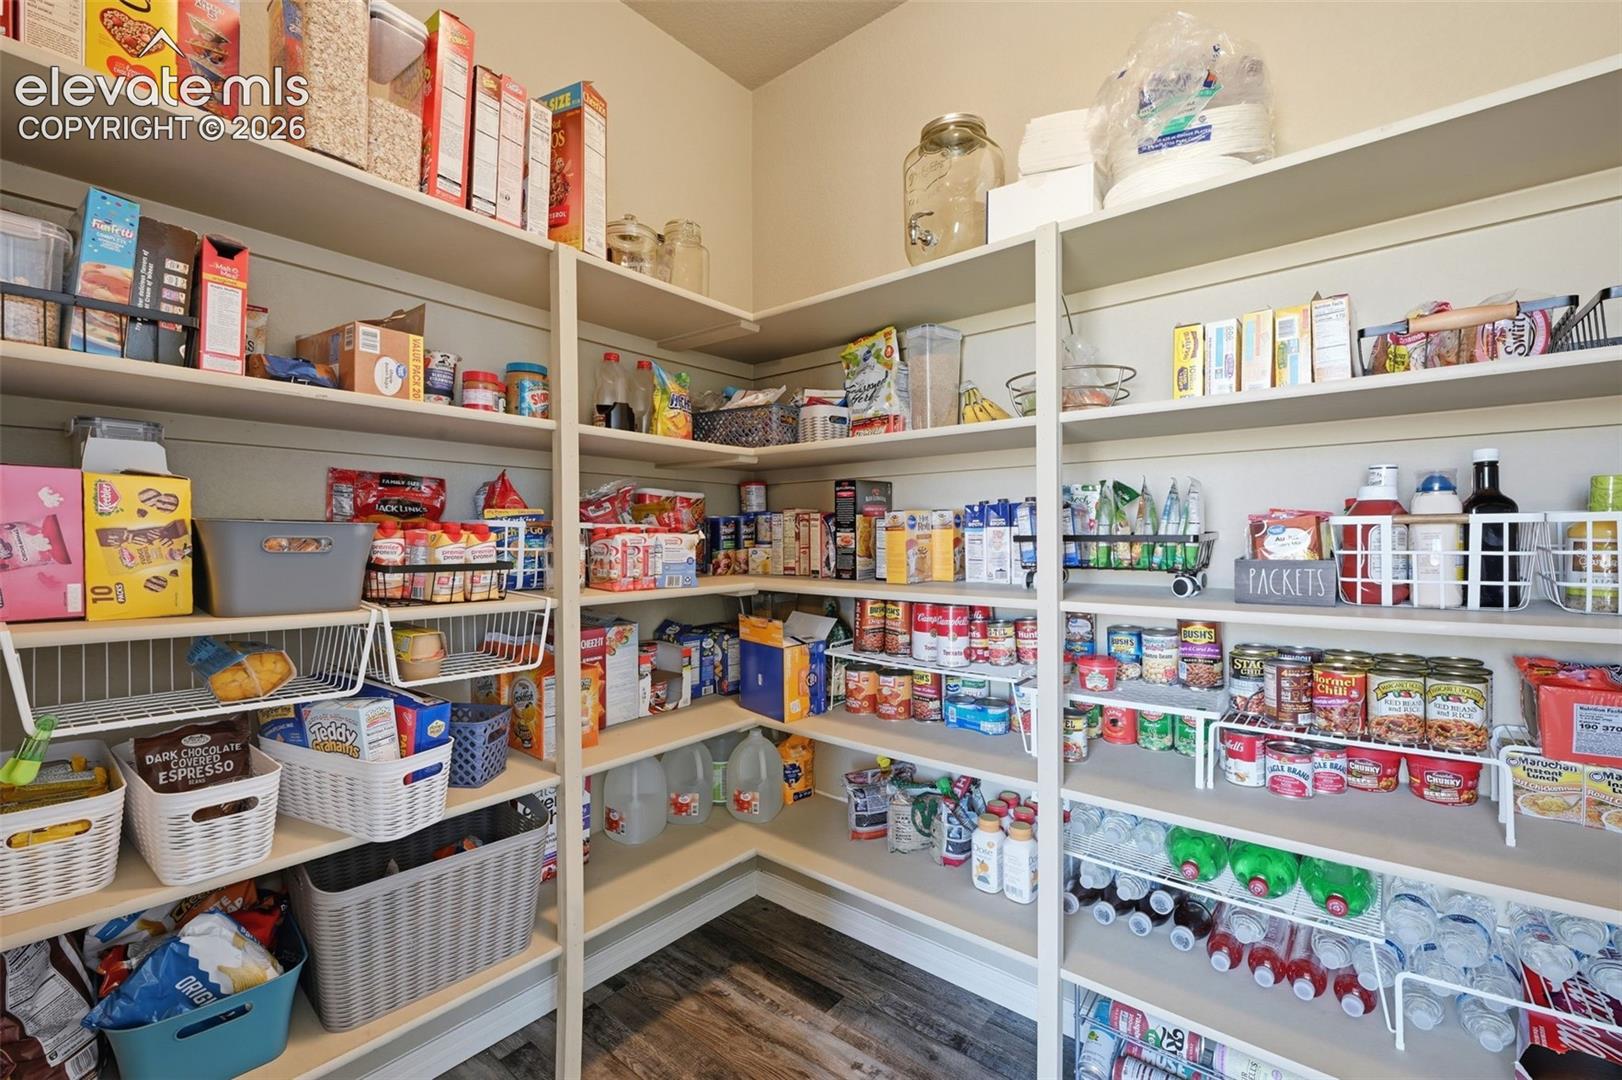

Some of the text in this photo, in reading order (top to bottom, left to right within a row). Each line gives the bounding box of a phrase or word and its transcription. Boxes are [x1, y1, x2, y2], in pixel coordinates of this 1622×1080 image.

[549, 92, 571, 108] SIZE
[412, 338, 423, 363] VALUE
[412, 364, 422, 387] PACK
[381, 478, 405, 487] FAMILY
[98, 483, 111, 513] Keebler
[375, 503, 399, 513] JACK
[1249, 568, 1325, 598] PACKETS
[91, 584, 115, 605] 10
[116, 583, 125, 603] PACKS
[1181, 629, 1215, 641] BUSH'S
[1240, 667, 1264, 677] CHIL
[1316, 683, 1348, 697] Chili
[1384, 699, 1400, 707] RED
[1433, 702, 1478, 714] RED BEANS
[1436, 708, 1474, 719] and RICE
[310, 721, 357, 748] Teddy
[1579, 723, 1622, 733] 190 370
[145, 742, 242, 766] DARK CHOCOLATE
[312, 738, 361, 760] Grahams
[170, 753, 222, 770] COVERED
[1349, 762, 1382, 776] CHUNKY
[1518, 756, 1578, 773] Maruchan
[158, 760, 235, 786] ESPRESSO
[1286, 765, 1310, 781] BRAND
[1522, 765, 1563, 777] Instant
[1527, 772, 1559, 783] Lunch
[1426, 775, 1462, 788] CHUNKY
